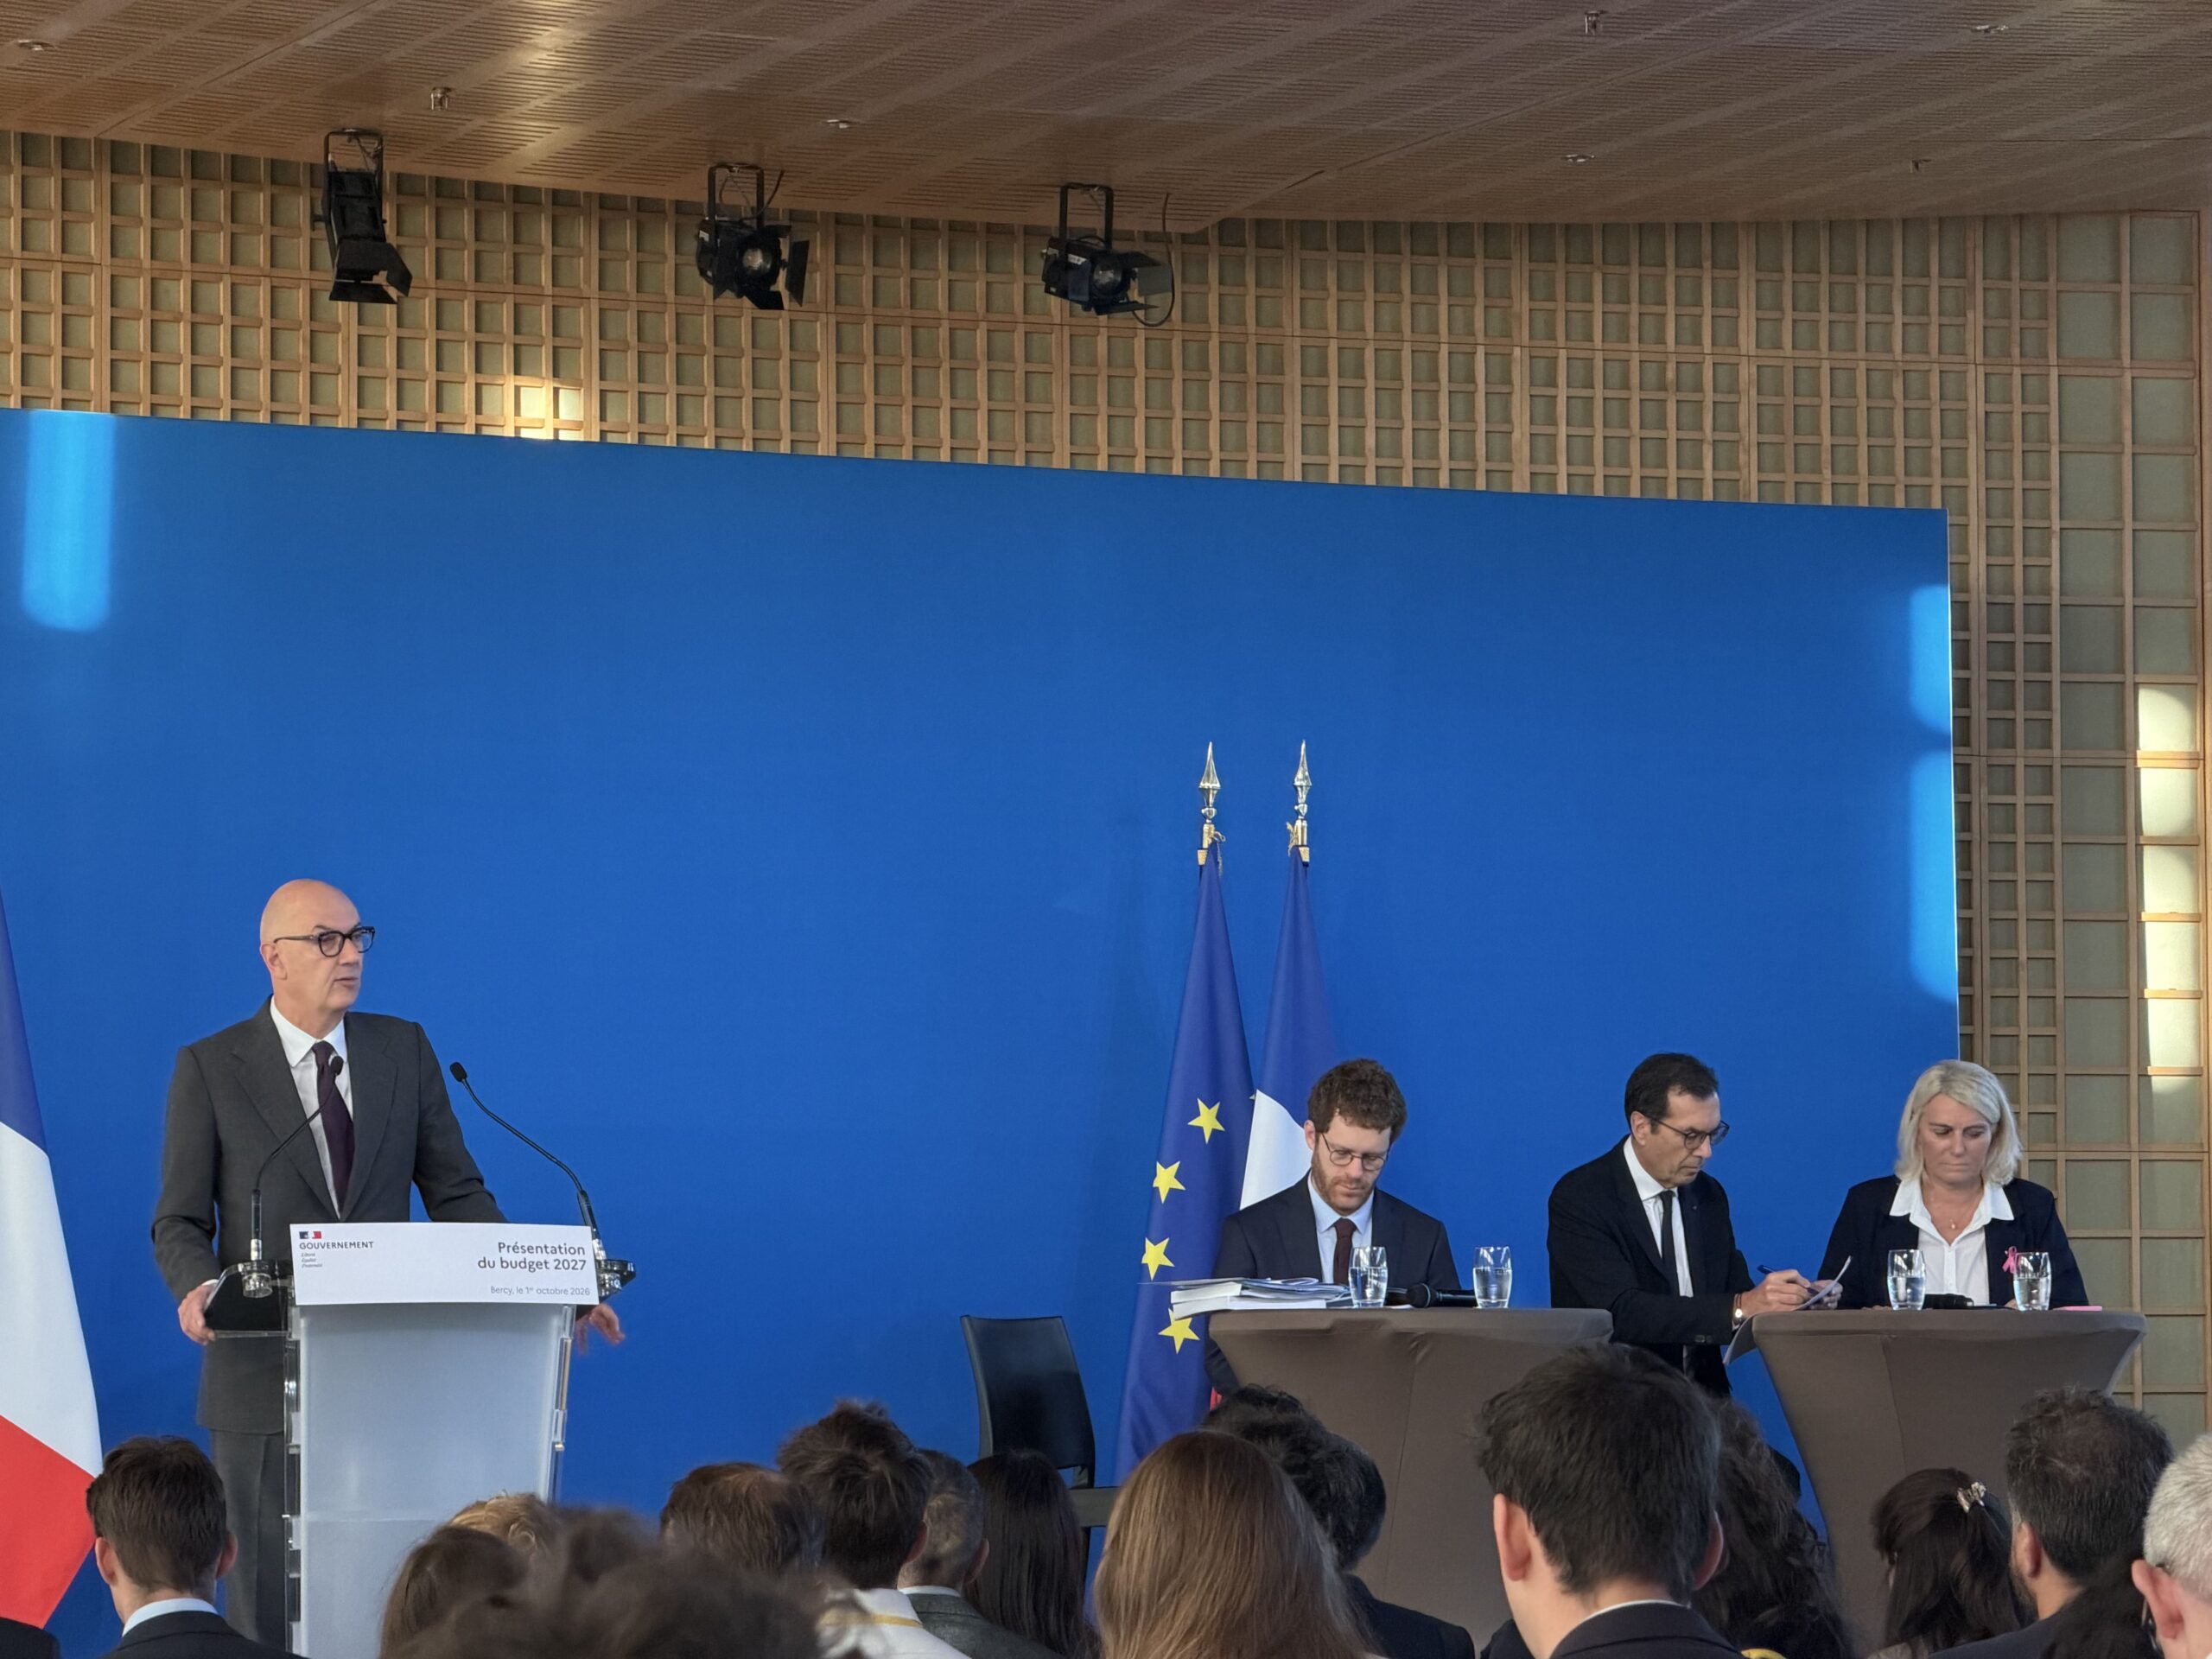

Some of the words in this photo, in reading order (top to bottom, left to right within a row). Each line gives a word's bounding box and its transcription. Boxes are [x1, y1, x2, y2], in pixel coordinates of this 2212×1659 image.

[298, 1241, 374, 1250] GOUVERNEMENT
[498, 1241, 586, 1255] Présentation
[477, 1256, 496, 1269] du
[500, 1256, 550, 1273] budget
[552, 1258, 588, 1270] 2027
[491, 1286, 515, 1296] Bercy,
[517, 1286, 524, 1294] le
[536, 1287, 569, 1295] octobre
[569, 1287, 591, 1296] 2026
